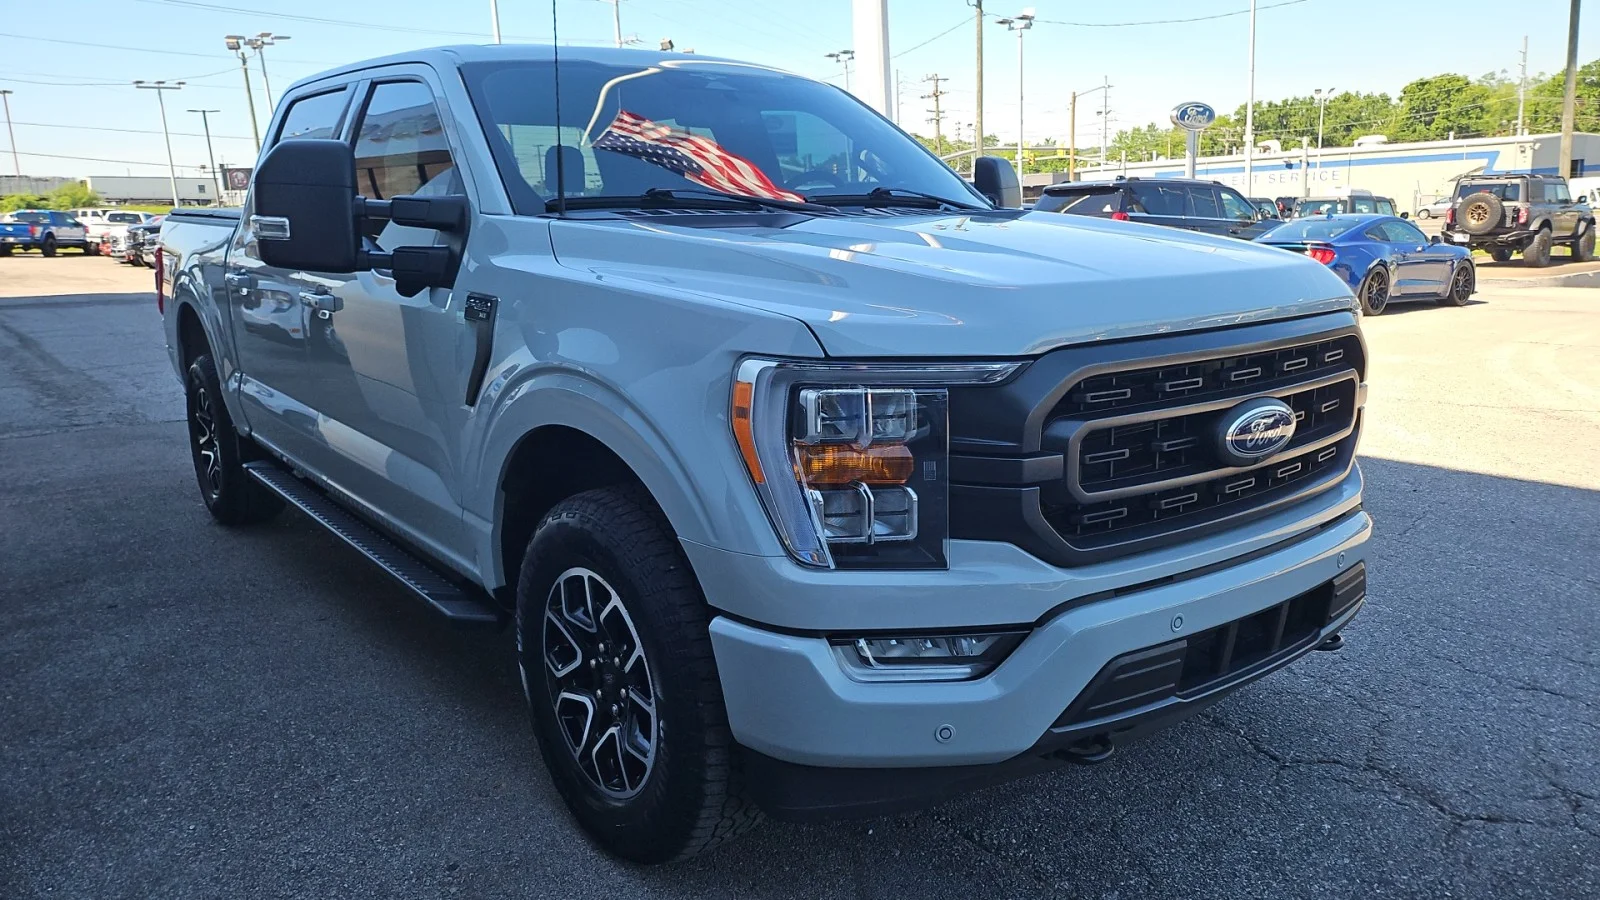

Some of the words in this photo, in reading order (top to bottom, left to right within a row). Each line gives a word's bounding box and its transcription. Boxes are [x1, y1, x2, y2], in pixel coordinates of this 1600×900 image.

[1184, 107, 1209, 124] Ford
[1268, 170, 1340, 184] SERICE
[1246, 417, 1284, 449] Ford
